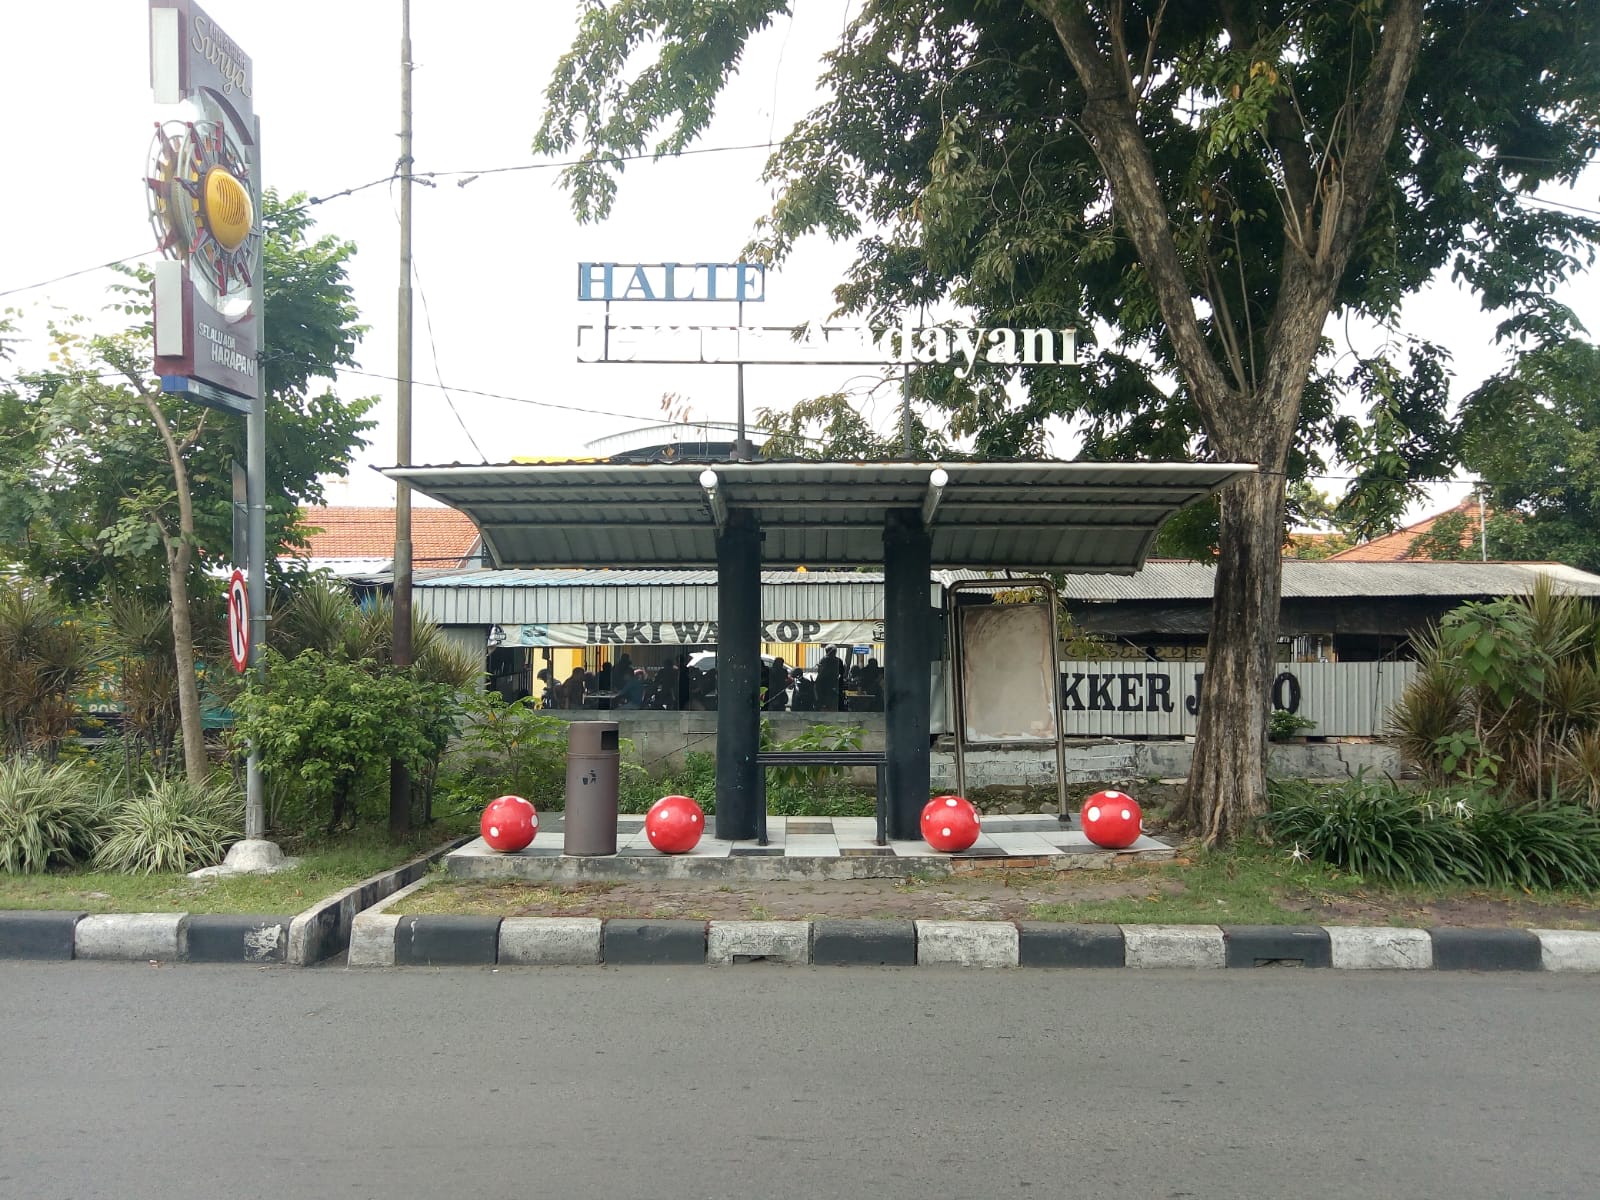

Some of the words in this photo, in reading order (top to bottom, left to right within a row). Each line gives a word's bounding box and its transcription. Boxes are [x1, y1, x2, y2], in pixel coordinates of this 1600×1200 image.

[192, 15, 252, 97] Surya
[577, 262, 766, 302] HALTE
[198, 322, 224, 345] SELALU
[797, 314, 1079, 379] Andayani
[211, 342, 254, 377] HARAPAN
[586, 622, 662, 644] IKKI
[672, 620, 821, 644] WAKOP
